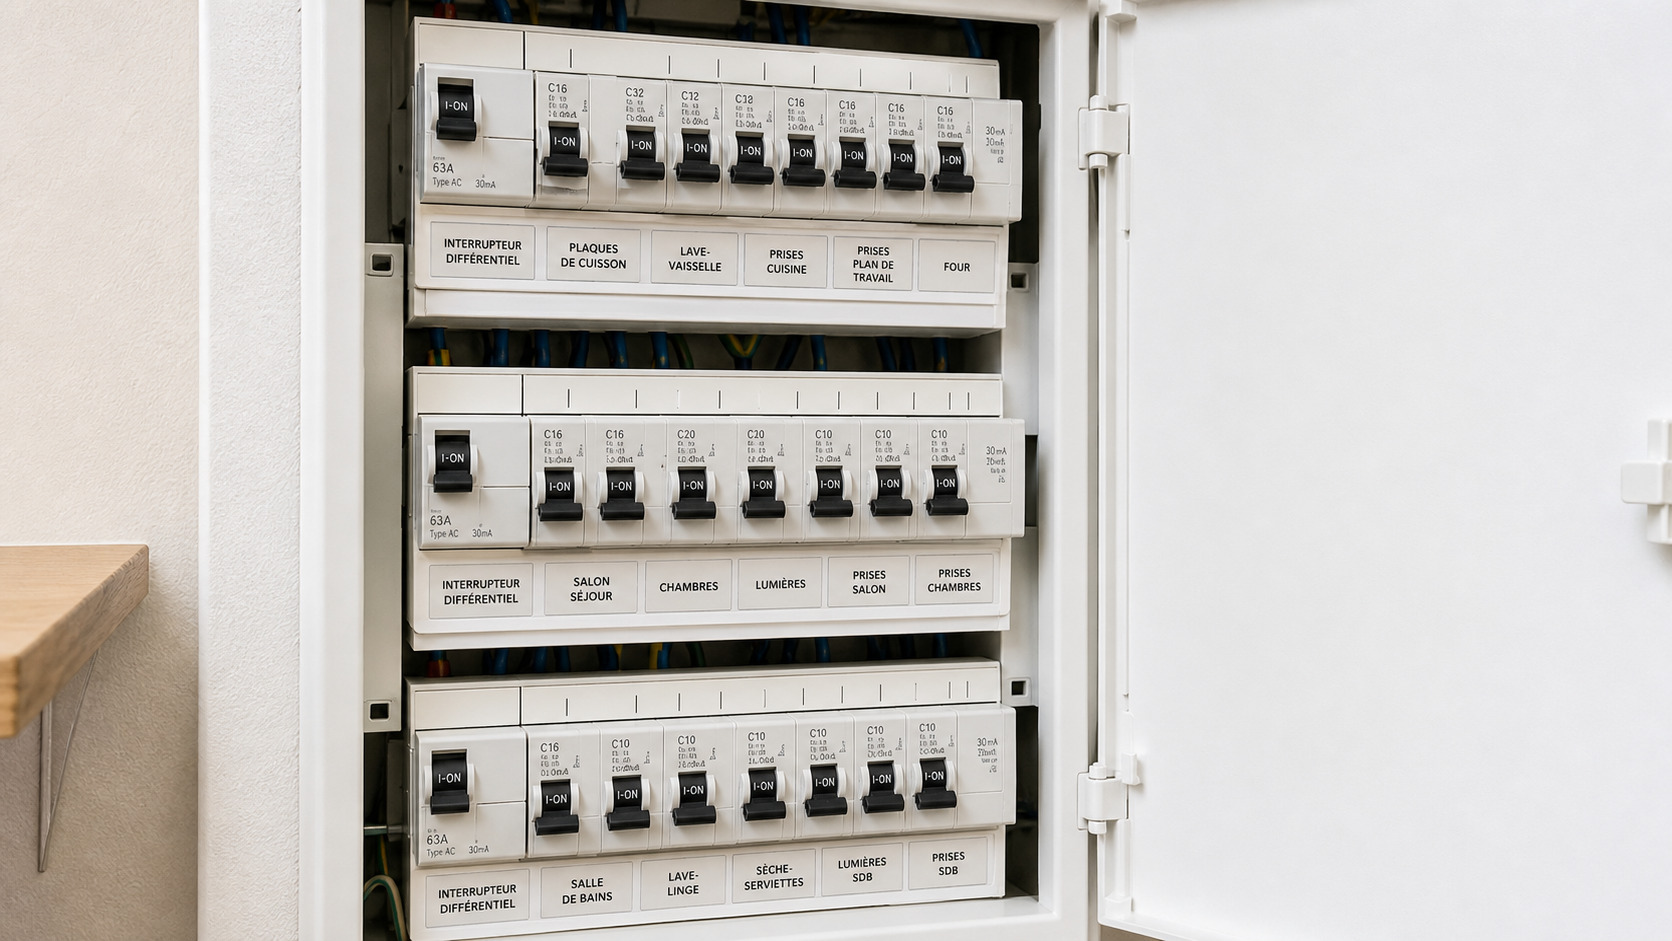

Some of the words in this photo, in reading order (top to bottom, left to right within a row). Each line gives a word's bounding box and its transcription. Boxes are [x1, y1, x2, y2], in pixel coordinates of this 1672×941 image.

[547, 83, 567, 94] C16
[625, 87, 643, 98] C32
[445, 101, 467, 112] I-ON
[787, 97, 804, 108] C16
[838, 100, 855, 111] C16
[887, 103, 904, 113] C16
[936, 106, 953, 116] C16
[554, 137, 575, 147] I-ON
[631, 141, 651, 150] I-ON
[686, 144, 707, 153] I-ON
[740, 146, 760, 156] I-ON
[793, 149, 812, 158] I-ON
[844, 151, 863, 160] I-ON
[893, 153, 912, 163] I-ON
[942, 155, 961, 165] I-ON
[432, 162, 454, 173] 63A
[432, 177, 449, 188] Type
[450, 178, 461, 187] AC
[444, 239, 521, 250] INTERRUPTEUR
[569, 243, 618, 254] PLAQUES
[680, 247, 710, 257] LAVE-
[769, 250, 803, 260] PRISES
[857, 246, 889, 257] PRISES
[446, 252, 520, 265] DIFFÉRENTIEL
[560, 258, 575, 268] DE
[578, 258, 626, 269] CUISSON
[668, 261, 721, 272] VAISSELLE
[766, 264, 806, 275] CUISINE
[852, 260, 878, 270] PLAN
[881, 261, 893, 270] DE
[943, 262, 970, 272] FOUR
[852, 273, 893, 283] TRAVAIL
[543, 430, 562, 440] C16
[605, 430, 624, 440] C16
[677, 430, 695, 440] C20
[747, 430, 764, 440] C20
[815, 430, 832, 440] C10
[874, 430, 891, 439] C10
[930, 430, 947, 439] C10
[441, 453, 464, 463] I-ON
[549, 482, 570, 492] I-ON
[610, 481, 631, 491] I-ON
[682, 481, 703, 491] I-ON
[752, 480, 772, 490] I-ON
[820, 480, 840, 489] I-ON
[880, 479, 899, 489] I-ON
[936, 479, 955, 488] I-ON
[429, 515, 451, 526] 63A
[429, 530, 446, 540] Type
[447, 529, 458, 538] AC
[472, 529, 492, 538] 30mA
[852, 570, 885, 580] PRISES
[938, 569, 970, 578] PRISES
[442, 579, 520, 590] INTERRUPTEUR
[573, 577, 609, 587] SALON
[755, 578, 805, 589] LUMIÈRES
[659, 582, 718, 593] CHAMBRES
[852, 585, 885, 595] SALON
[927, 582, 981, 593] CHAMBRES
[444, 593, 518, 604] DIFFÉRENTIEL
[570, 590, 612, 601] SÉJOUR
[866, 726, 883, 736] C10
[918, 723, 935, 733] C10
[747, 732, 765, 742] C10
[809, 729, 826, 739] C10
[611, 739, 629, 750] C10
[677, 735, 695, 746] C10
[540, 742, 559, 753] C16
[438, 773, 460, 784] I-ON
[872, 775, 891, 784] I-ON
[924, 771, 943, 781] I-ON
[753, 782, 773, 791] I-ON
[815, 778, 834, 787] I-ON
[617, 790, 637, 800] I-ON
[683, 786, 703, 796] I-ON
[545, 794, 567, 804] I-ON
[426, 834, 448, 845] 63A
[426, 849, 443, 859] Type
[444, 847, 455, 856] AC
[932, 852, 965, 863] PRISES
[838, 856, 886, 869] LUMIÈRES
[756, 864, 795, 875] SÈCHE-
[938, 866, 958, 876] SDB
[668, 871, 698, 882] LAVE-
[852, 873, 872, 883] SDB
[571, 878, 603, 889] SALLE
[744, 878, 803, 890] SERVIETTES
[438, 884, 516, 898] INTERRUPTEUR
[667, 885, 698, 896] LINGE
[562, 895, 576, 905] DE
[579, 892, 612, 903] BAINS
[439, 896, 515, 913] DIFFÉRENTIEL
